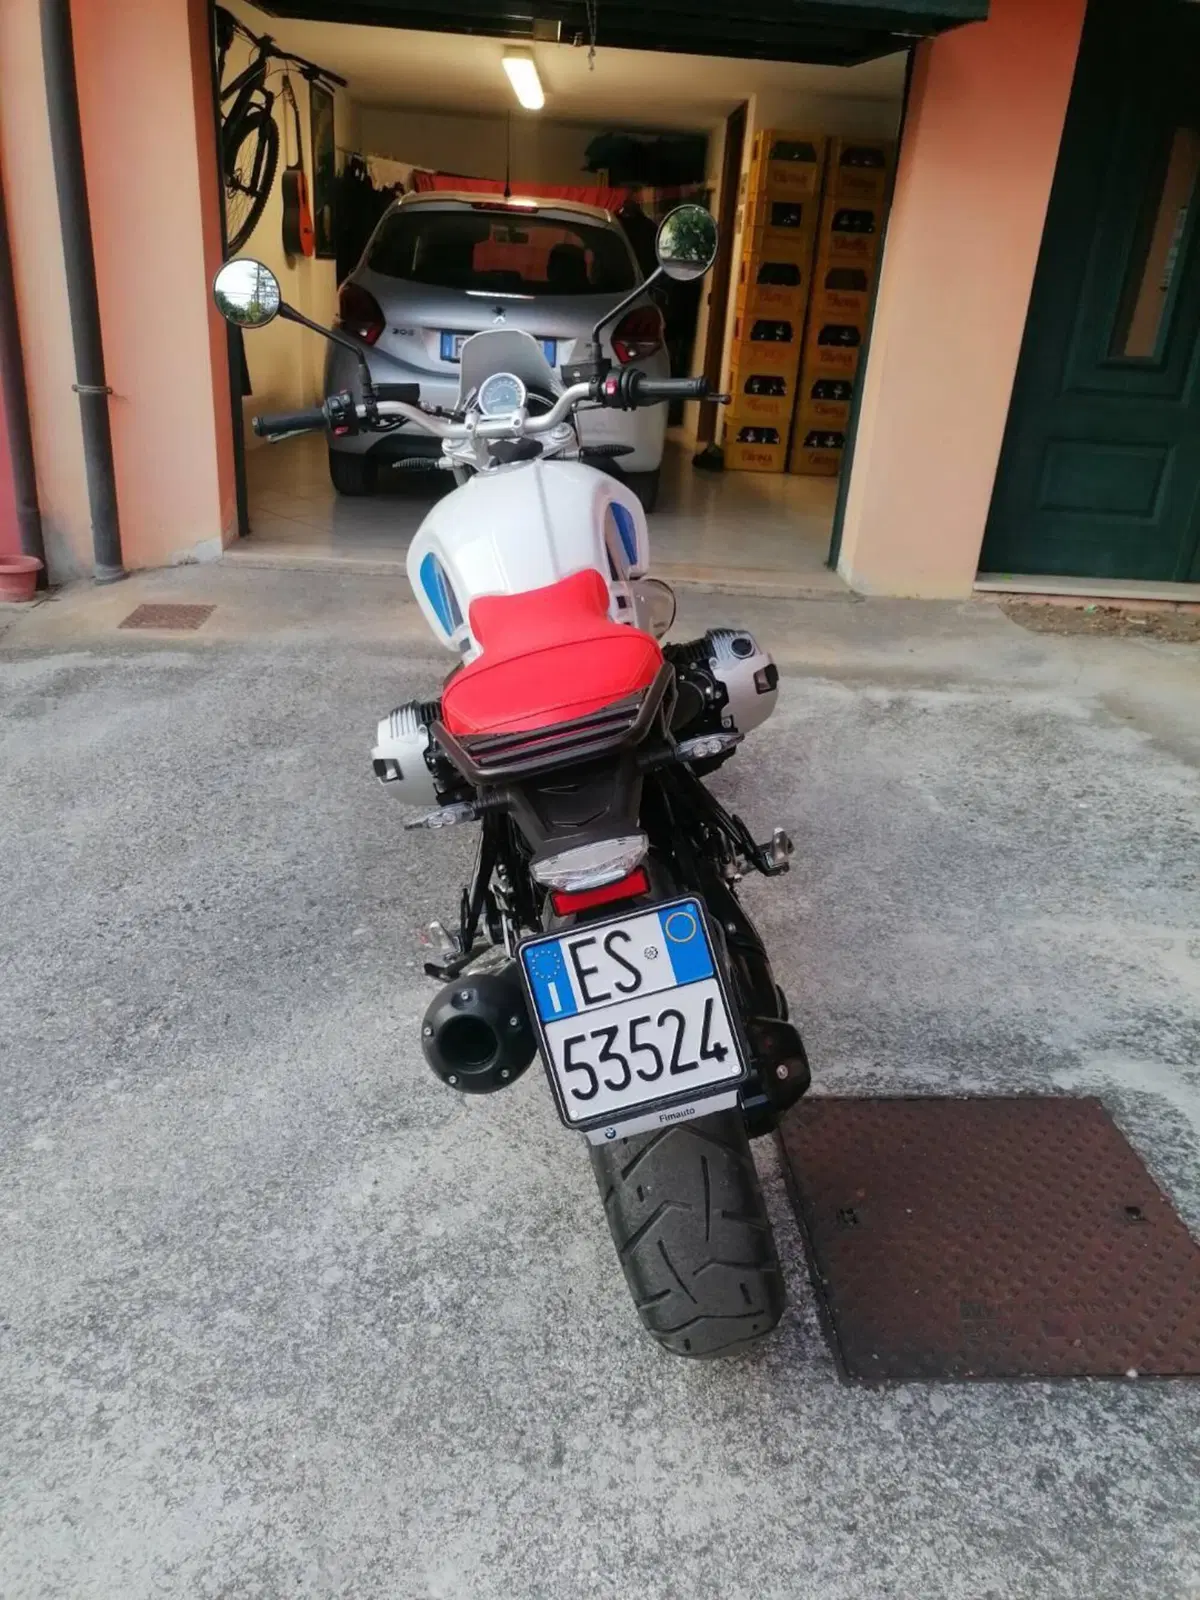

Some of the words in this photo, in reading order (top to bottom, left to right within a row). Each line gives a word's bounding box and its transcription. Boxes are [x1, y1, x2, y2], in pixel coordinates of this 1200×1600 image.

[568, 930, 642, 1005] ES
[563, 997, 729, 1101] 53524
[659, 1106, 696, 1123] Fimauto
